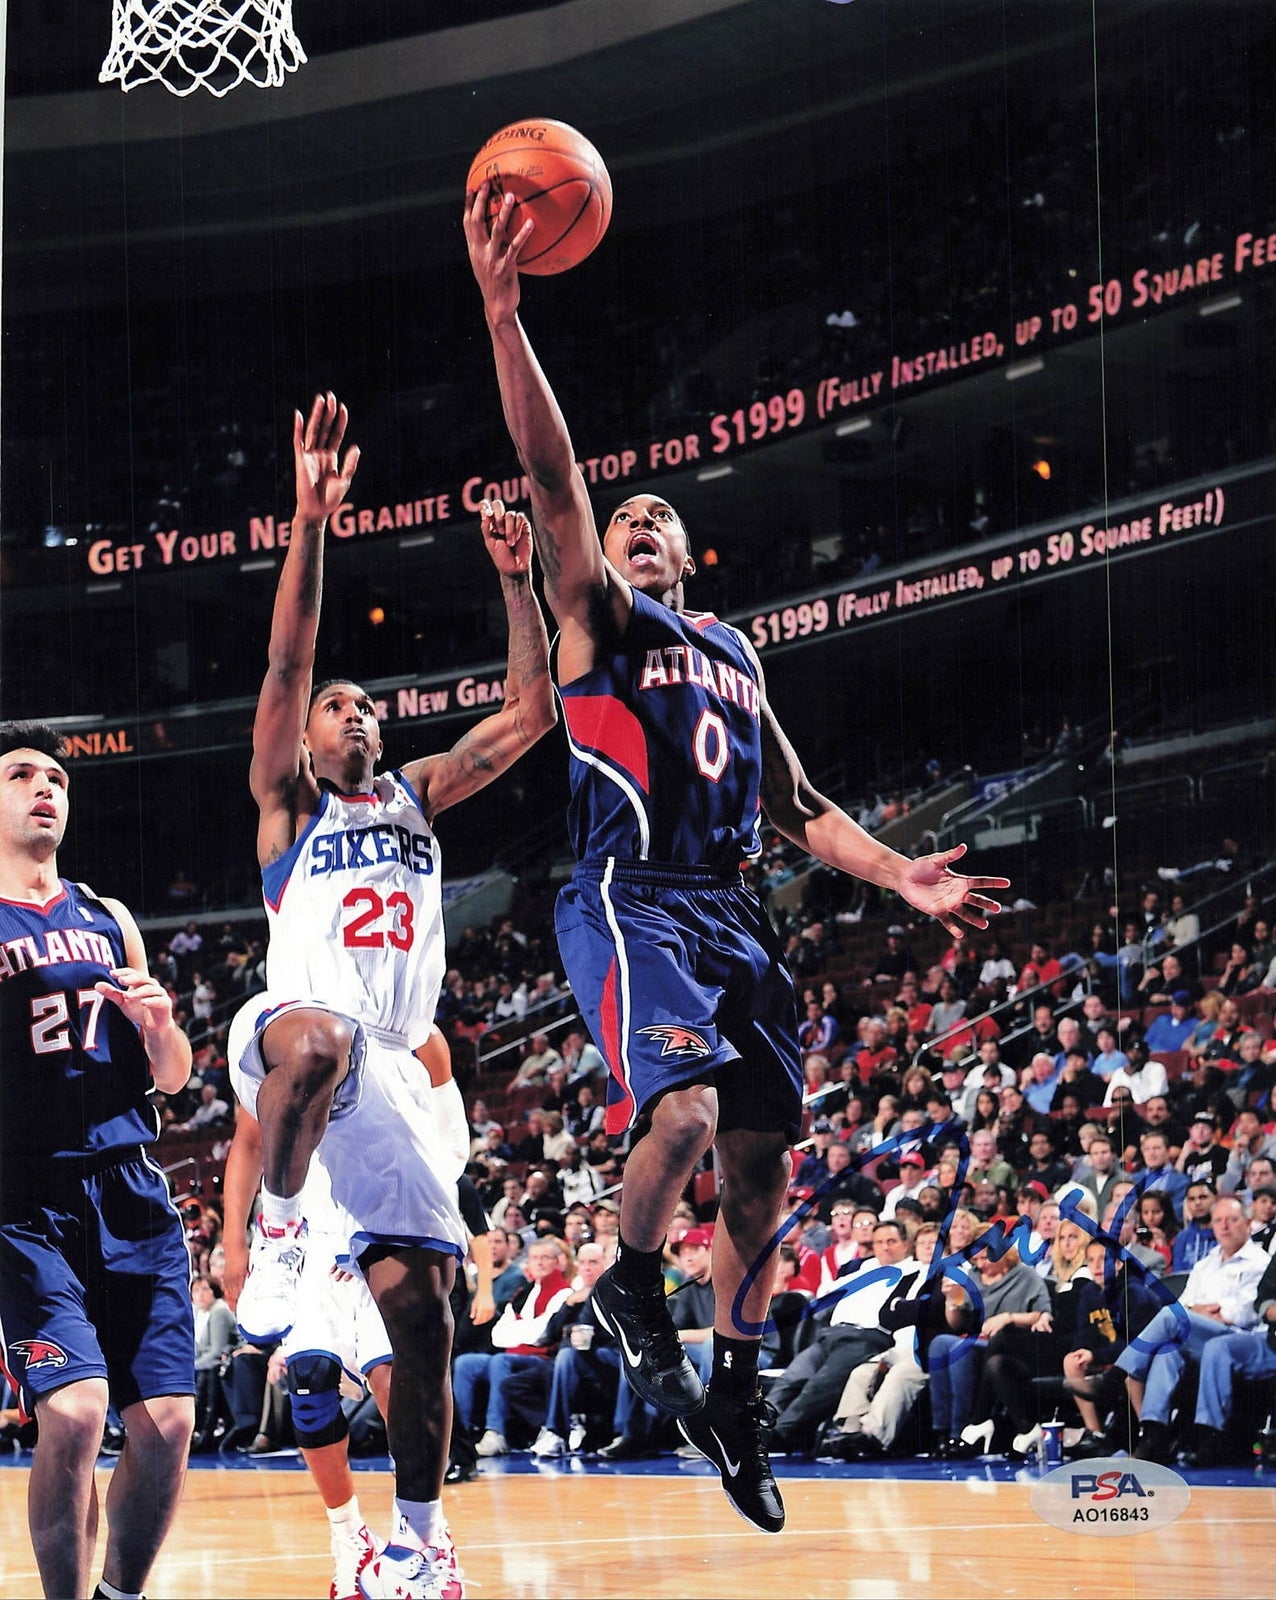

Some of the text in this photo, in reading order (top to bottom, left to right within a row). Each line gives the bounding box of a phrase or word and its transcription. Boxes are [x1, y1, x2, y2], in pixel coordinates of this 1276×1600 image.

[249, 515, 292, 551] NE
[1088, 279, 1122, 322] 50
[1234, 232, 1276, 272] FEE
[1047, 531, 1074, 565] 50
[638, 644, 761, 728] ATLANTA
[692, 706, 730, 784] 0
[311, 824, 434, 877] SIXERS
[342, 887, 414, 953] 23
[30, 987, 105, 1056] 27
